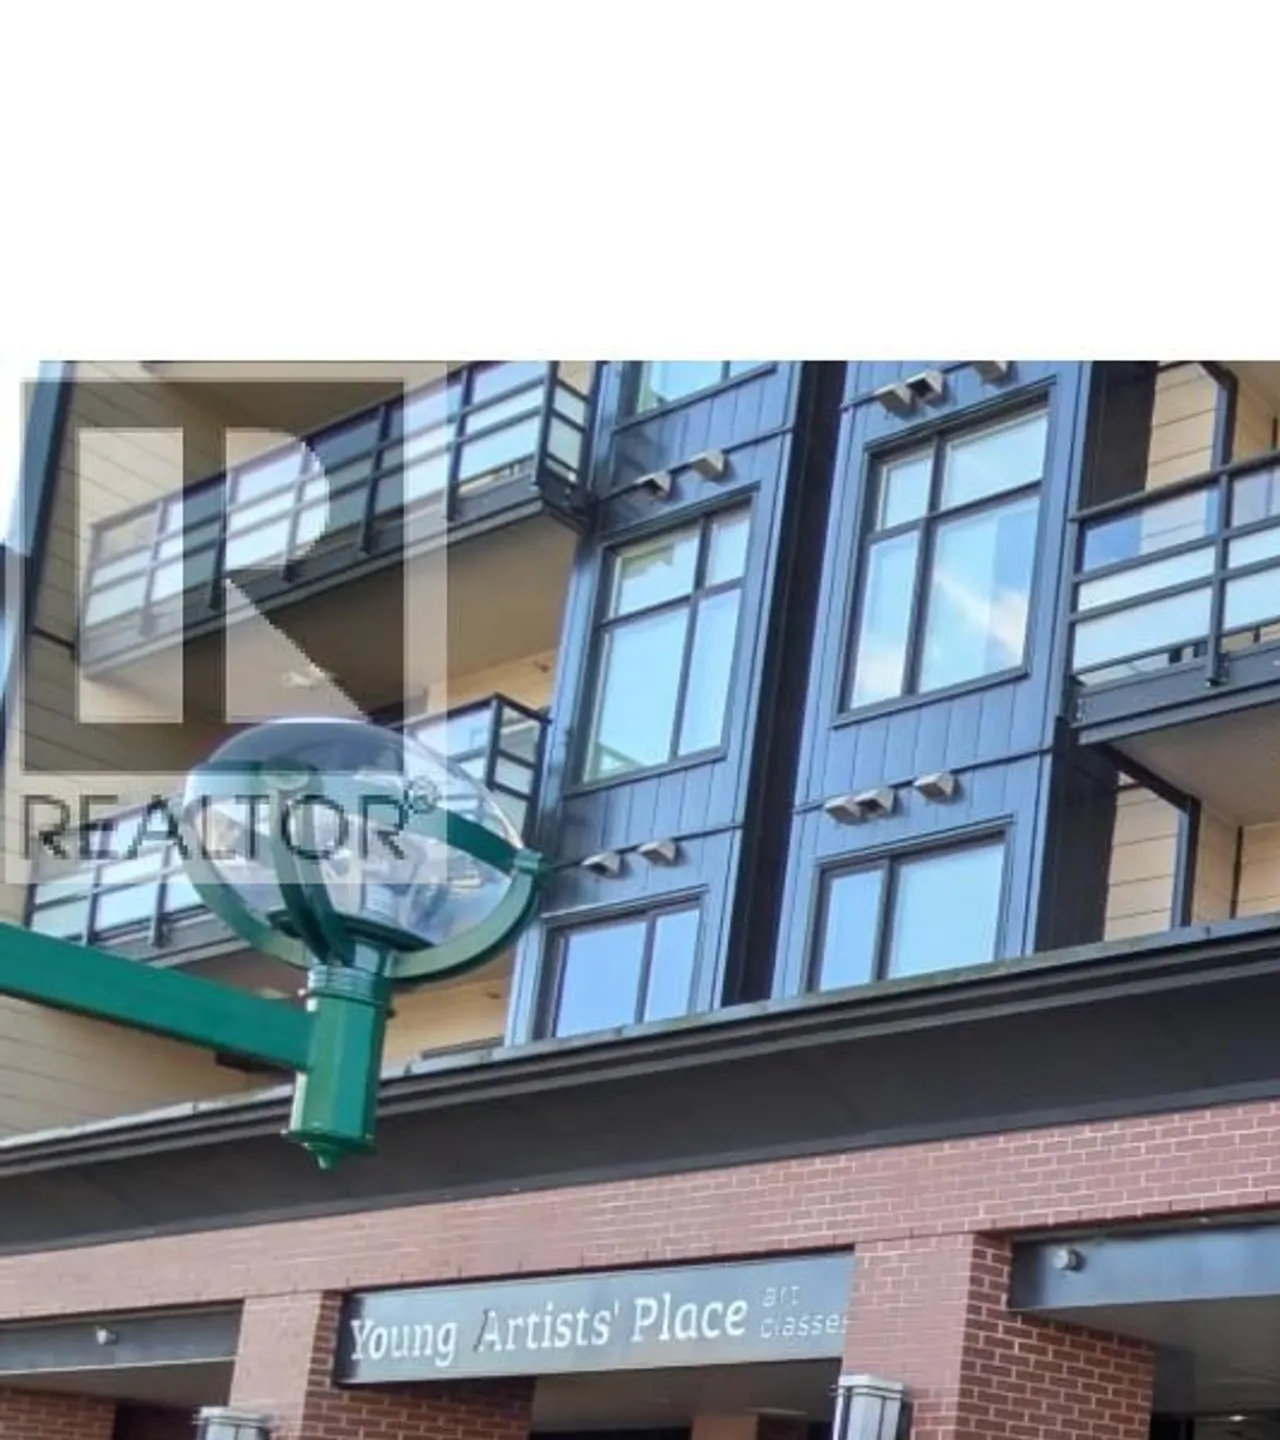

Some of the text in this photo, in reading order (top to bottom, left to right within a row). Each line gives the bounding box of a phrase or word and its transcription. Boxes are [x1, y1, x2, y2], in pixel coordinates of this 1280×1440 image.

[762, 1286, 800, 1308] art
[350, 1291, 748, 1367] Young Artists' Place
